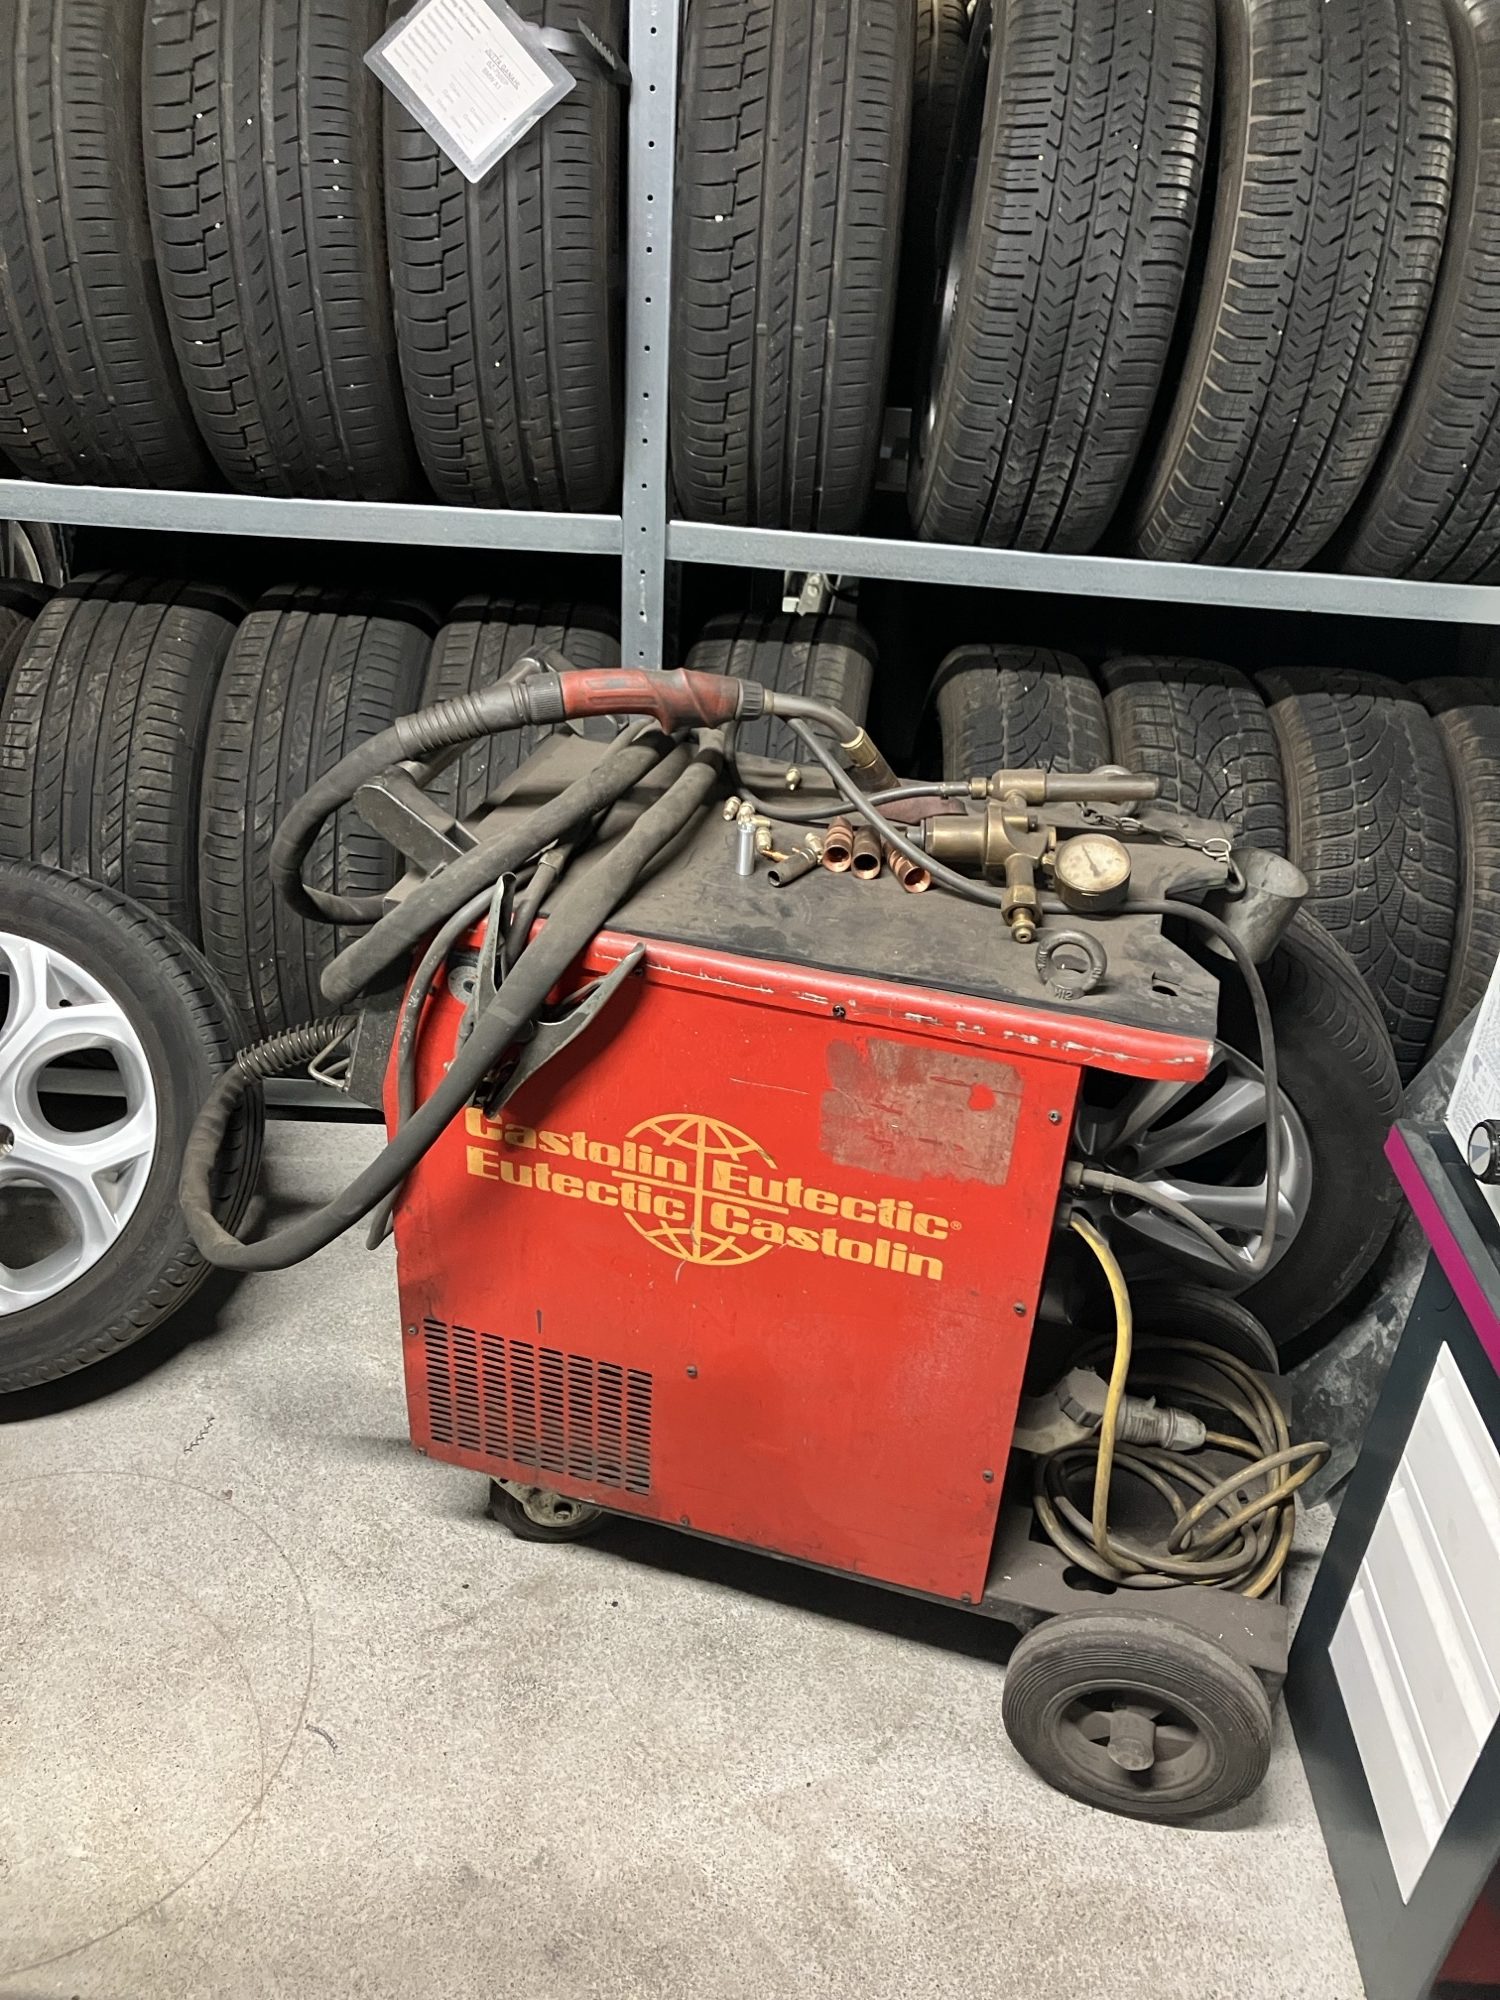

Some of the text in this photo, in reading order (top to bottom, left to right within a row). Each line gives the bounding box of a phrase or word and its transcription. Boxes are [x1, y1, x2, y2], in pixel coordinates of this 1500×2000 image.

[465, 1107, 687, 1182] Castolin
[466, 1145, 943, 1280] Eutectic Castolin
